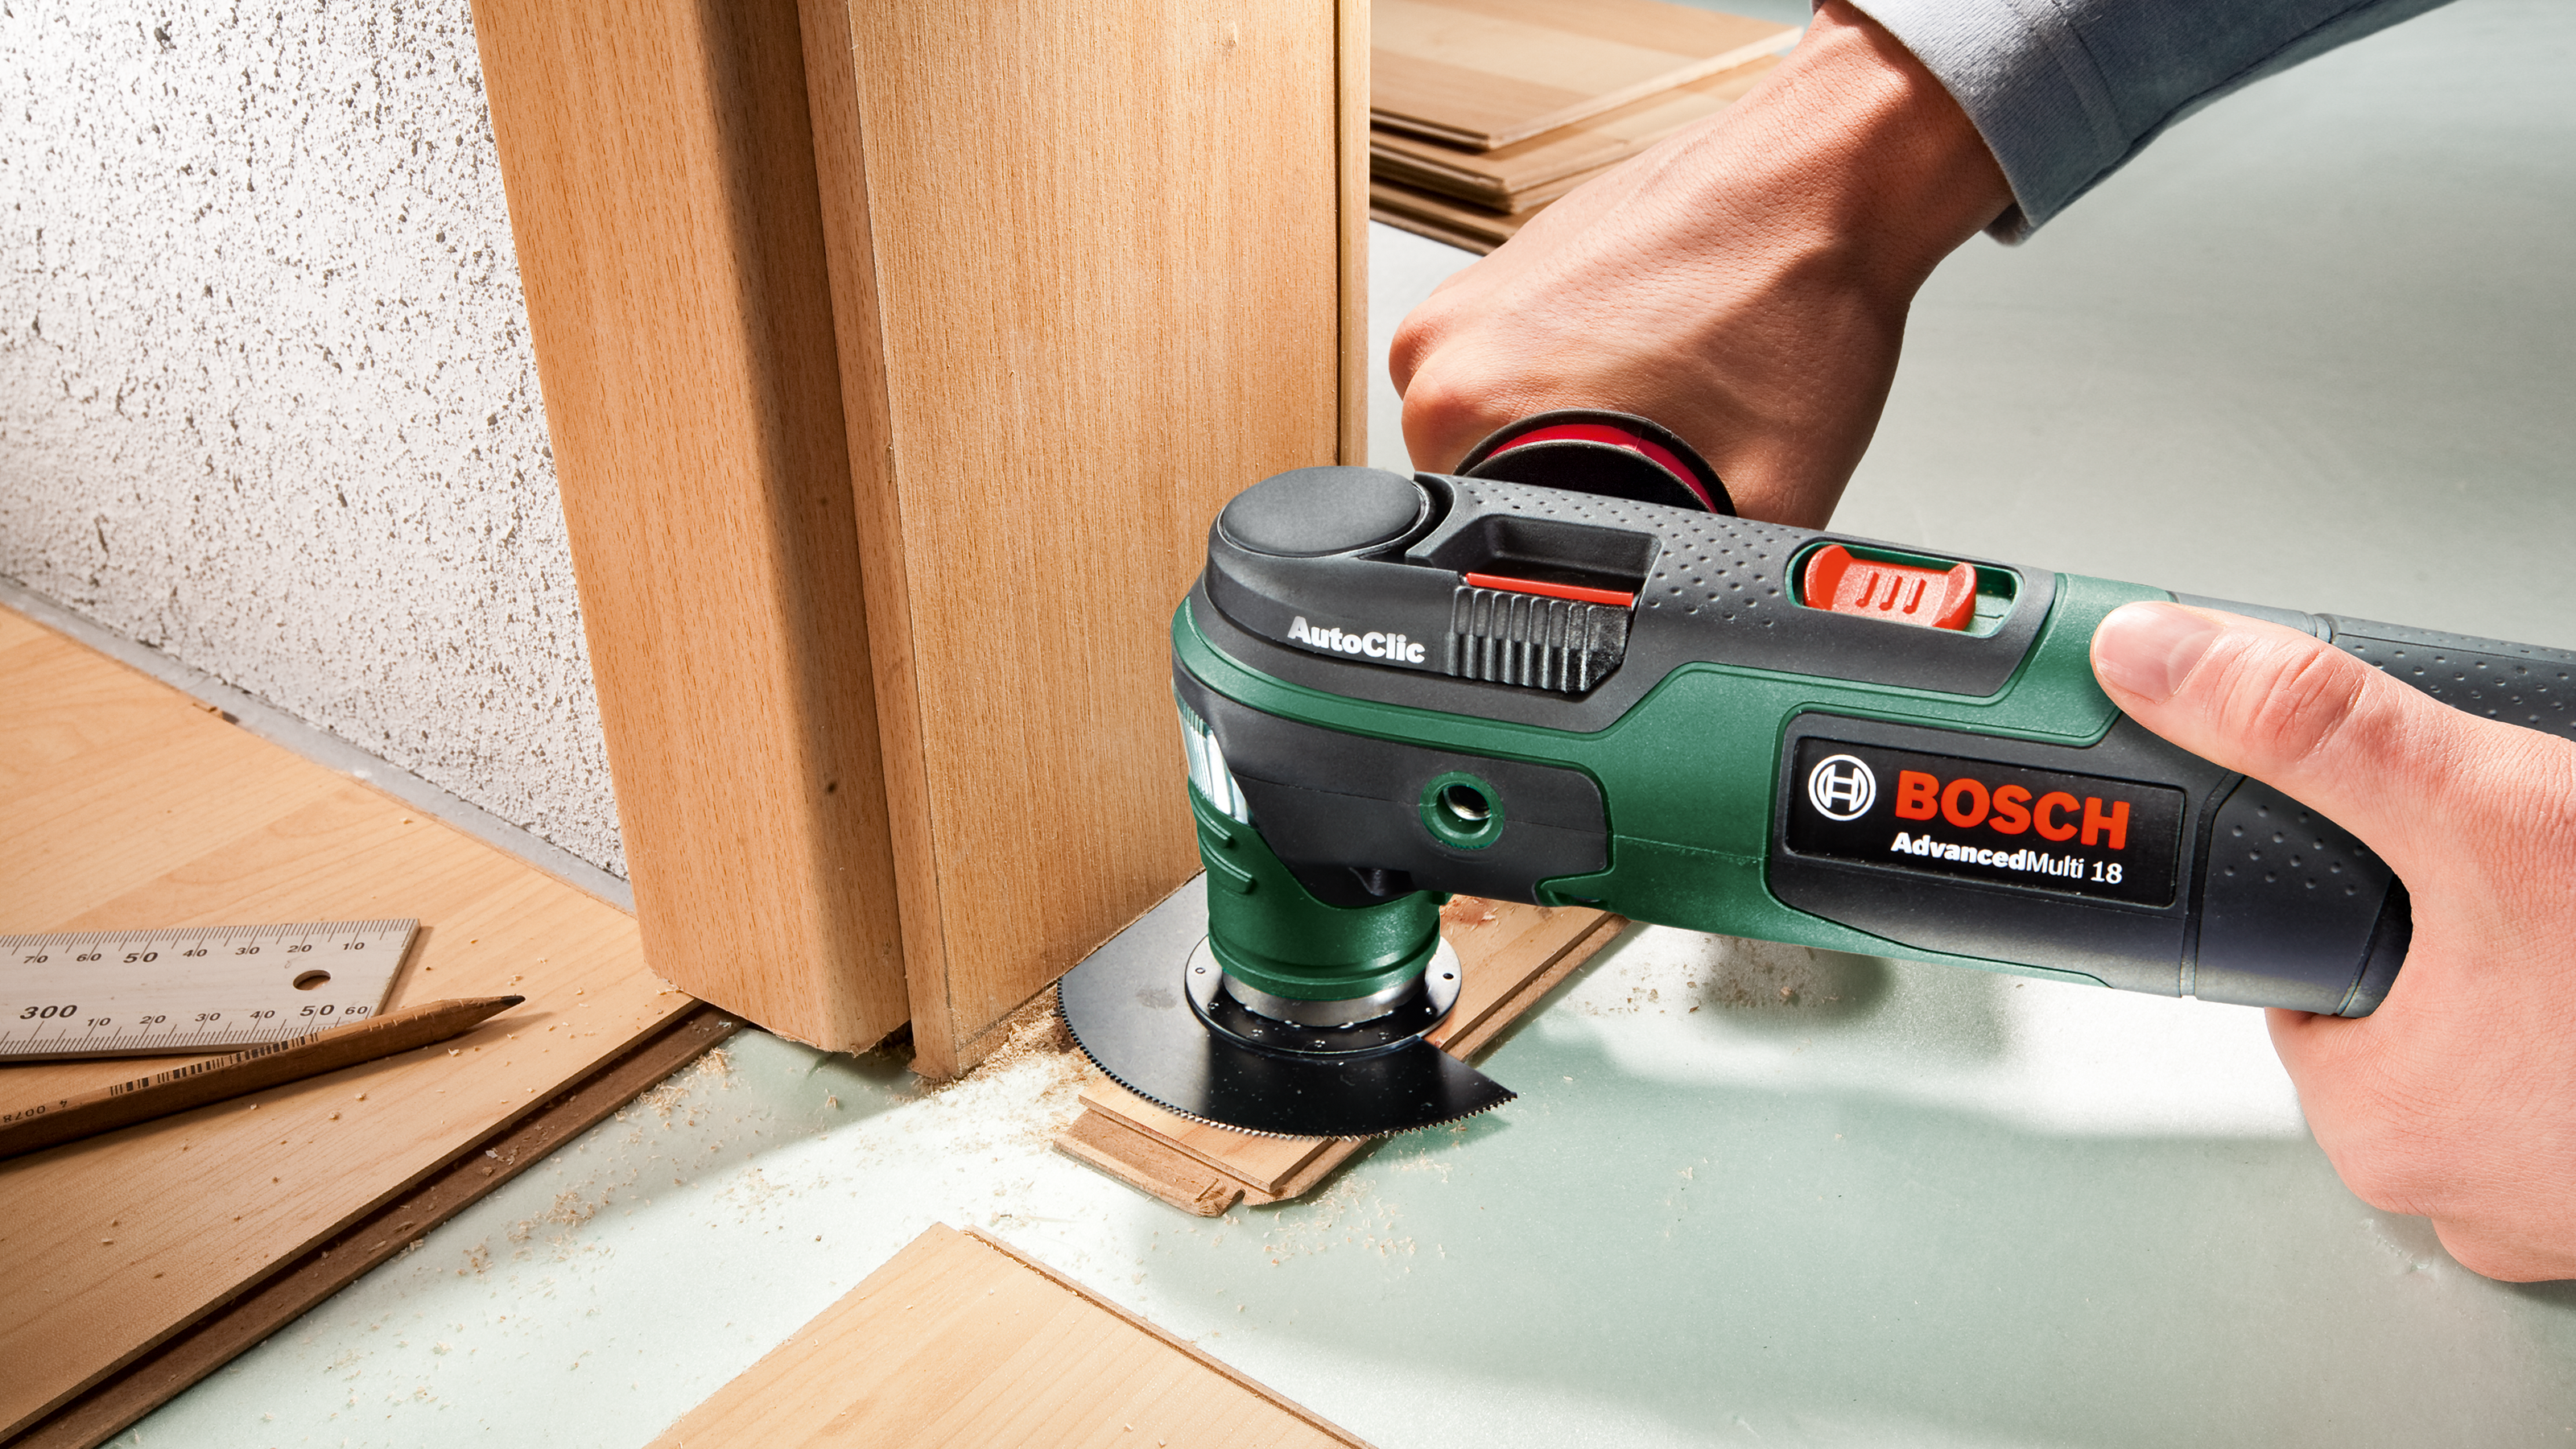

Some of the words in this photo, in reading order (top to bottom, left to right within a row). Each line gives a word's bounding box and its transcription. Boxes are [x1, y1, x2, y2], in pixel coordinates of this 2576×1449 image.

[1287, 616, 1425, 663] AutoClic
[1895, 770, 2130, 850] BOSCH
[1891, 832, 2083, 879] AdvancedMulti
[2091, 861, 2122, 884] 18
[23, 956, 48, 964] 70
[76, 953, 101, 962] 60
[123, 952, 159, 964] 50
[183, 948, 208, 957] 40
[235, 947, 260, 955] 30
[287, 944, 312, 953] 20
[343, 942, 365, 951] 10
[19, 1005, 77, 1020] 300
[88, 1018, 111, 1026] 10
[138, 1015, 167, 1024] 20
[195, 1013, 221, 1022] 30
[250, 1010, 275, 1019] 40
[299, 1005, 334, 1016] 50
[345, 1006, 368, 1015] 60
